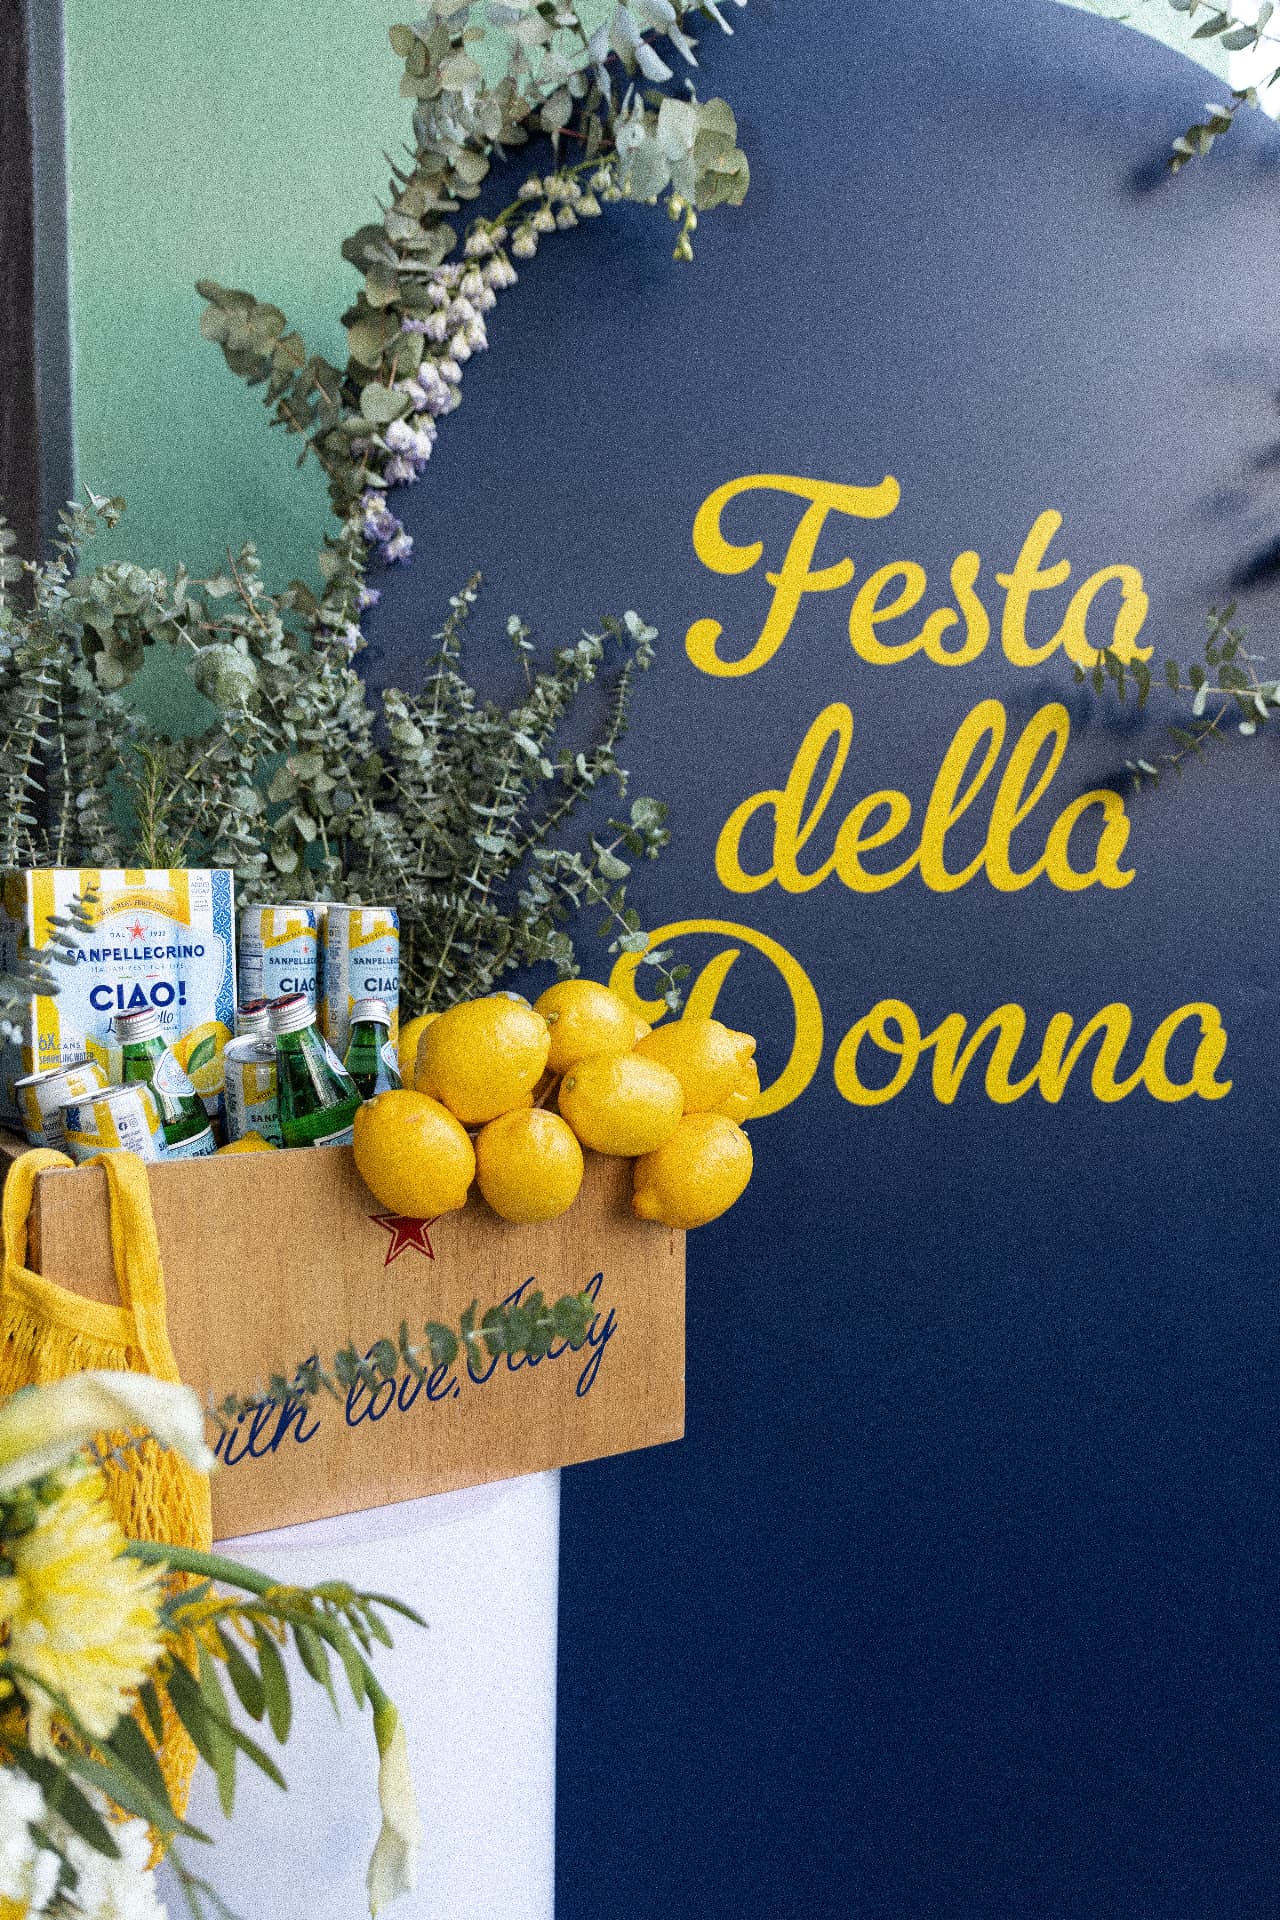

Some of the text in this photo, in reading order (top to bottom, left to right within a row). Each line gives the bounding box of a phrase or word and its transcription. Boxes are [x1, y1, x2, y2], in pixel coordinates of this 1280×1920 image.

[685, 473, 1155, 678] Festa
[715, 698, 1137, 895] della
[66, 943, 206, 963] SANPELLEGRINO
[89, 980, 187, 1011] CIAO!
[608, 918, 1234, 1120] Donna
[214, 1355, 321, 1466] ith
